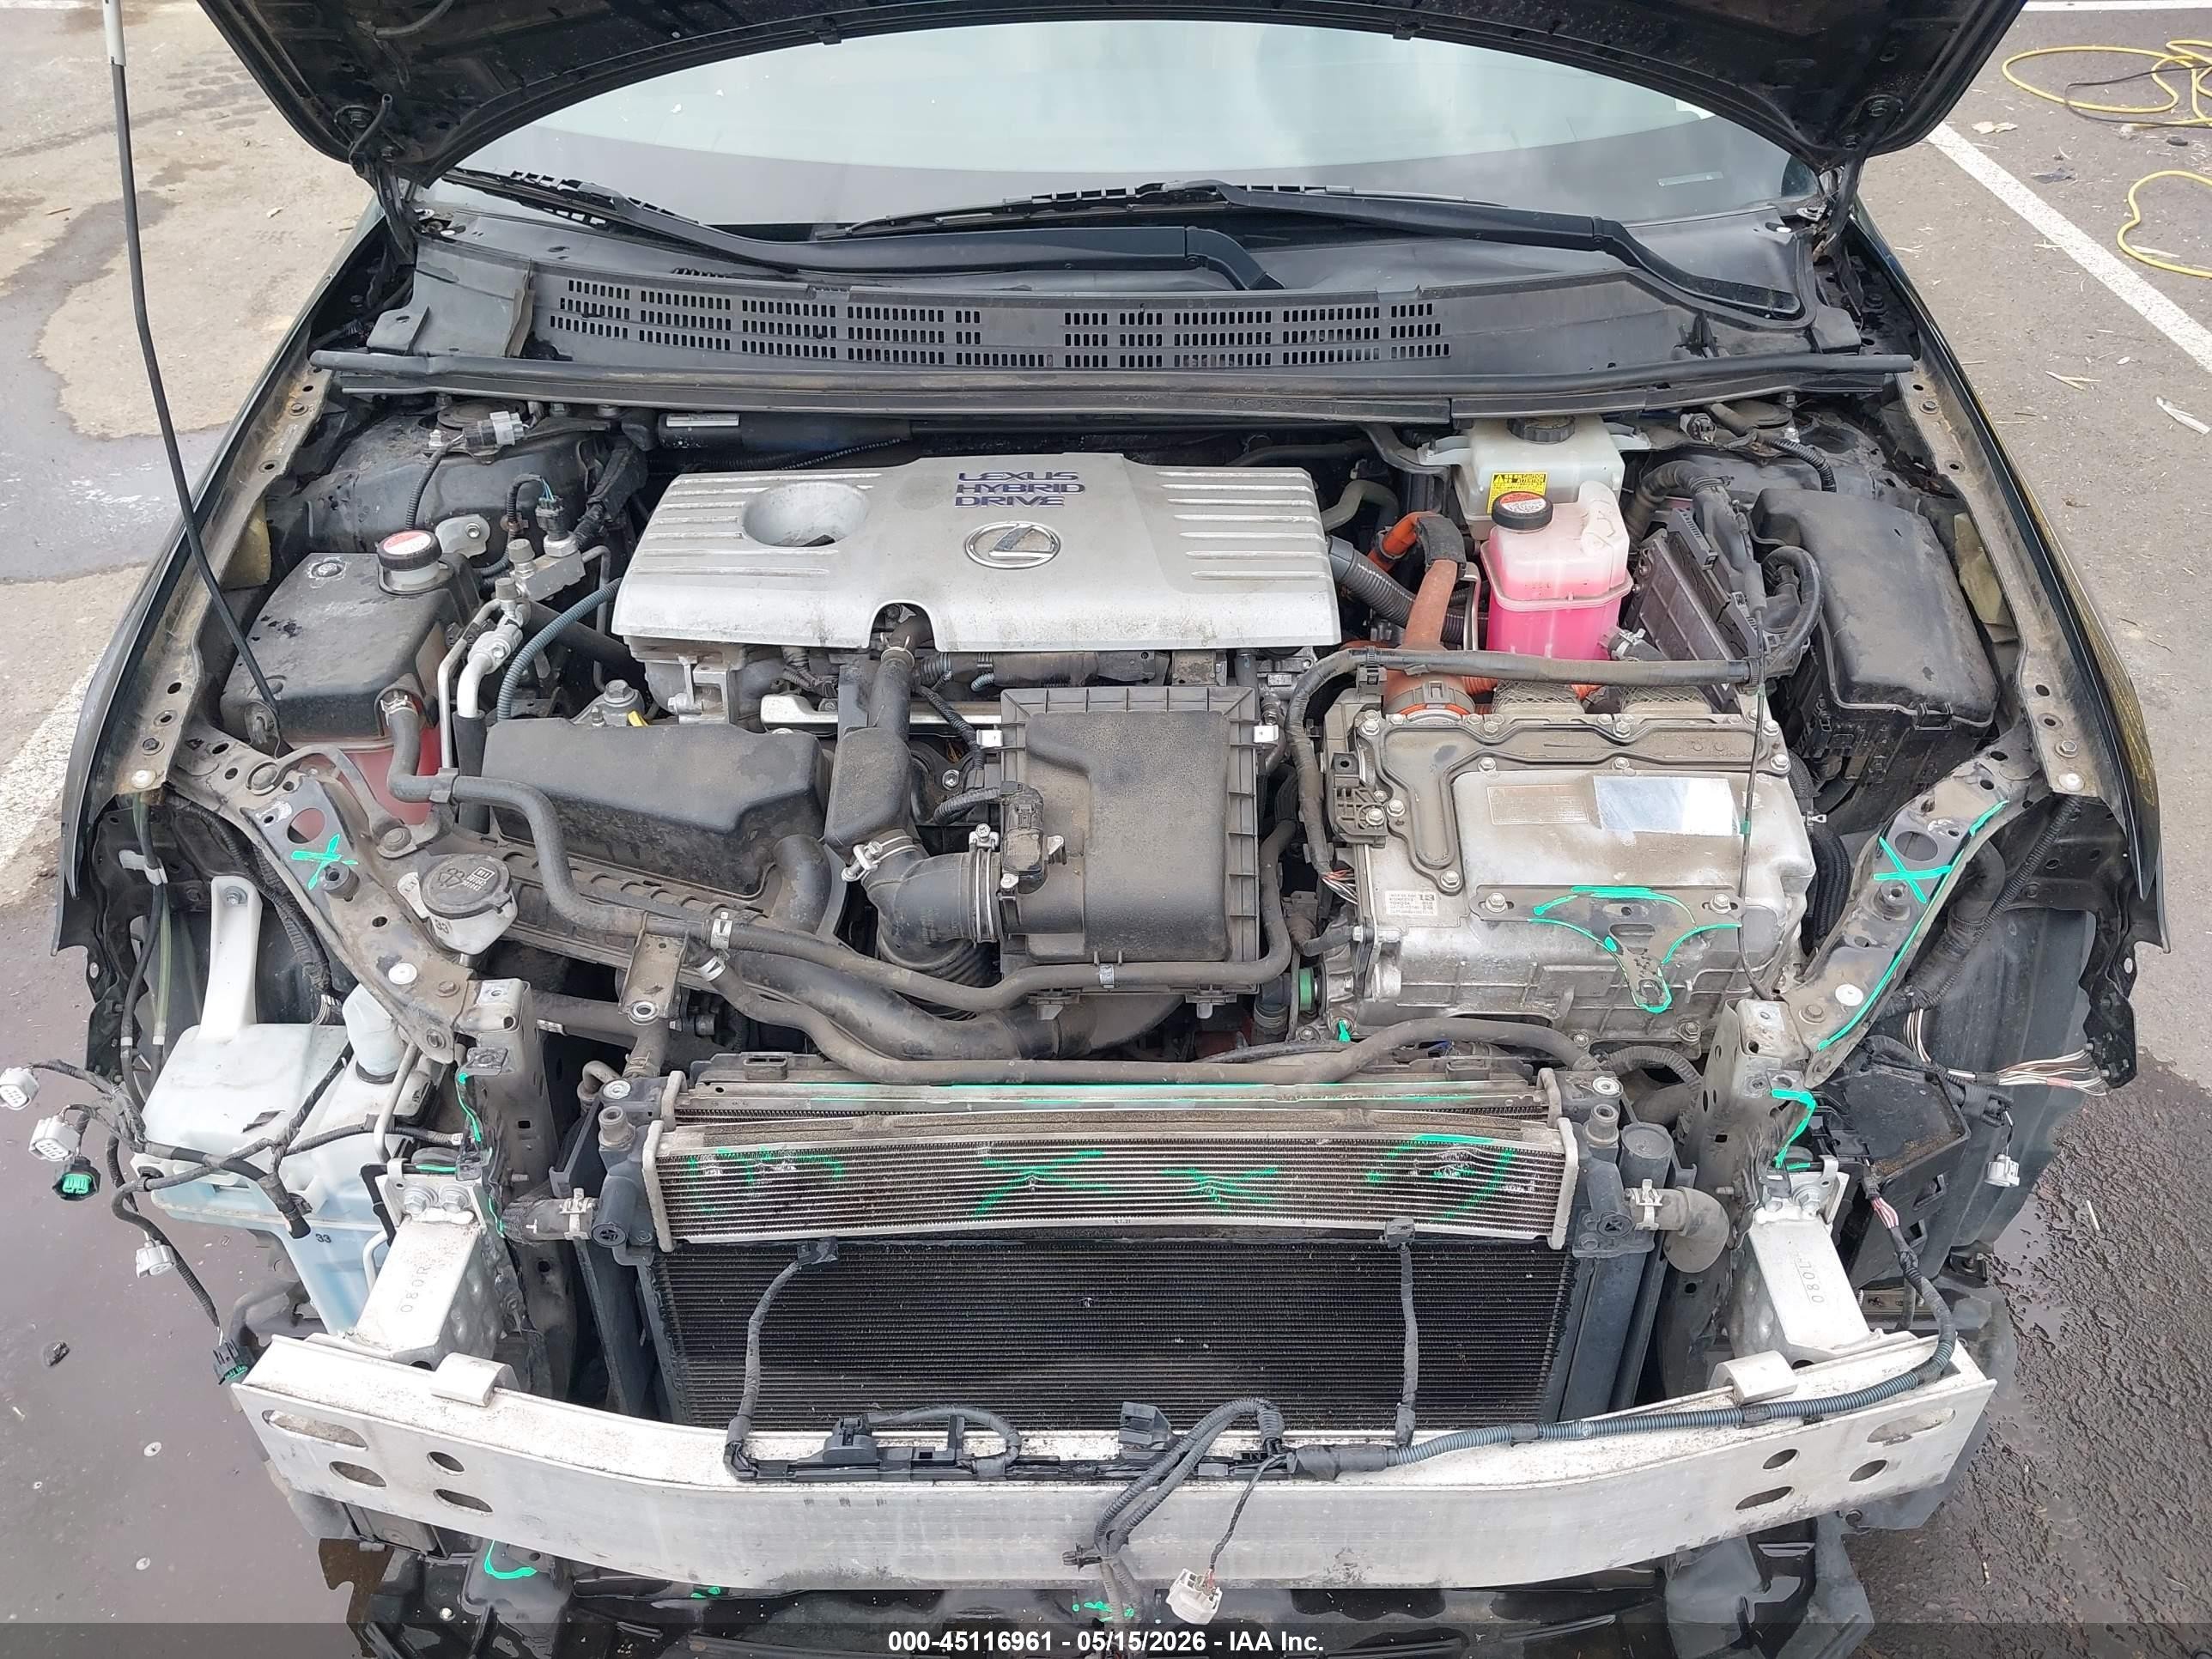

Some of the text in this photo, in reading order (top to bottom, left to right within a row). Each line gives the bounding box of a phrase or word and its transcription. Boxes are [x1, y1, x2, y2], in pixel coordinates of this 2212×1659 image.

[957, 471, 1079, 482] LEXUS
[957, 483, 1085, 495] HYBRID
[955, 495, 1065, 507] DRIVE
[315, 1233, 331, 1243] 33
